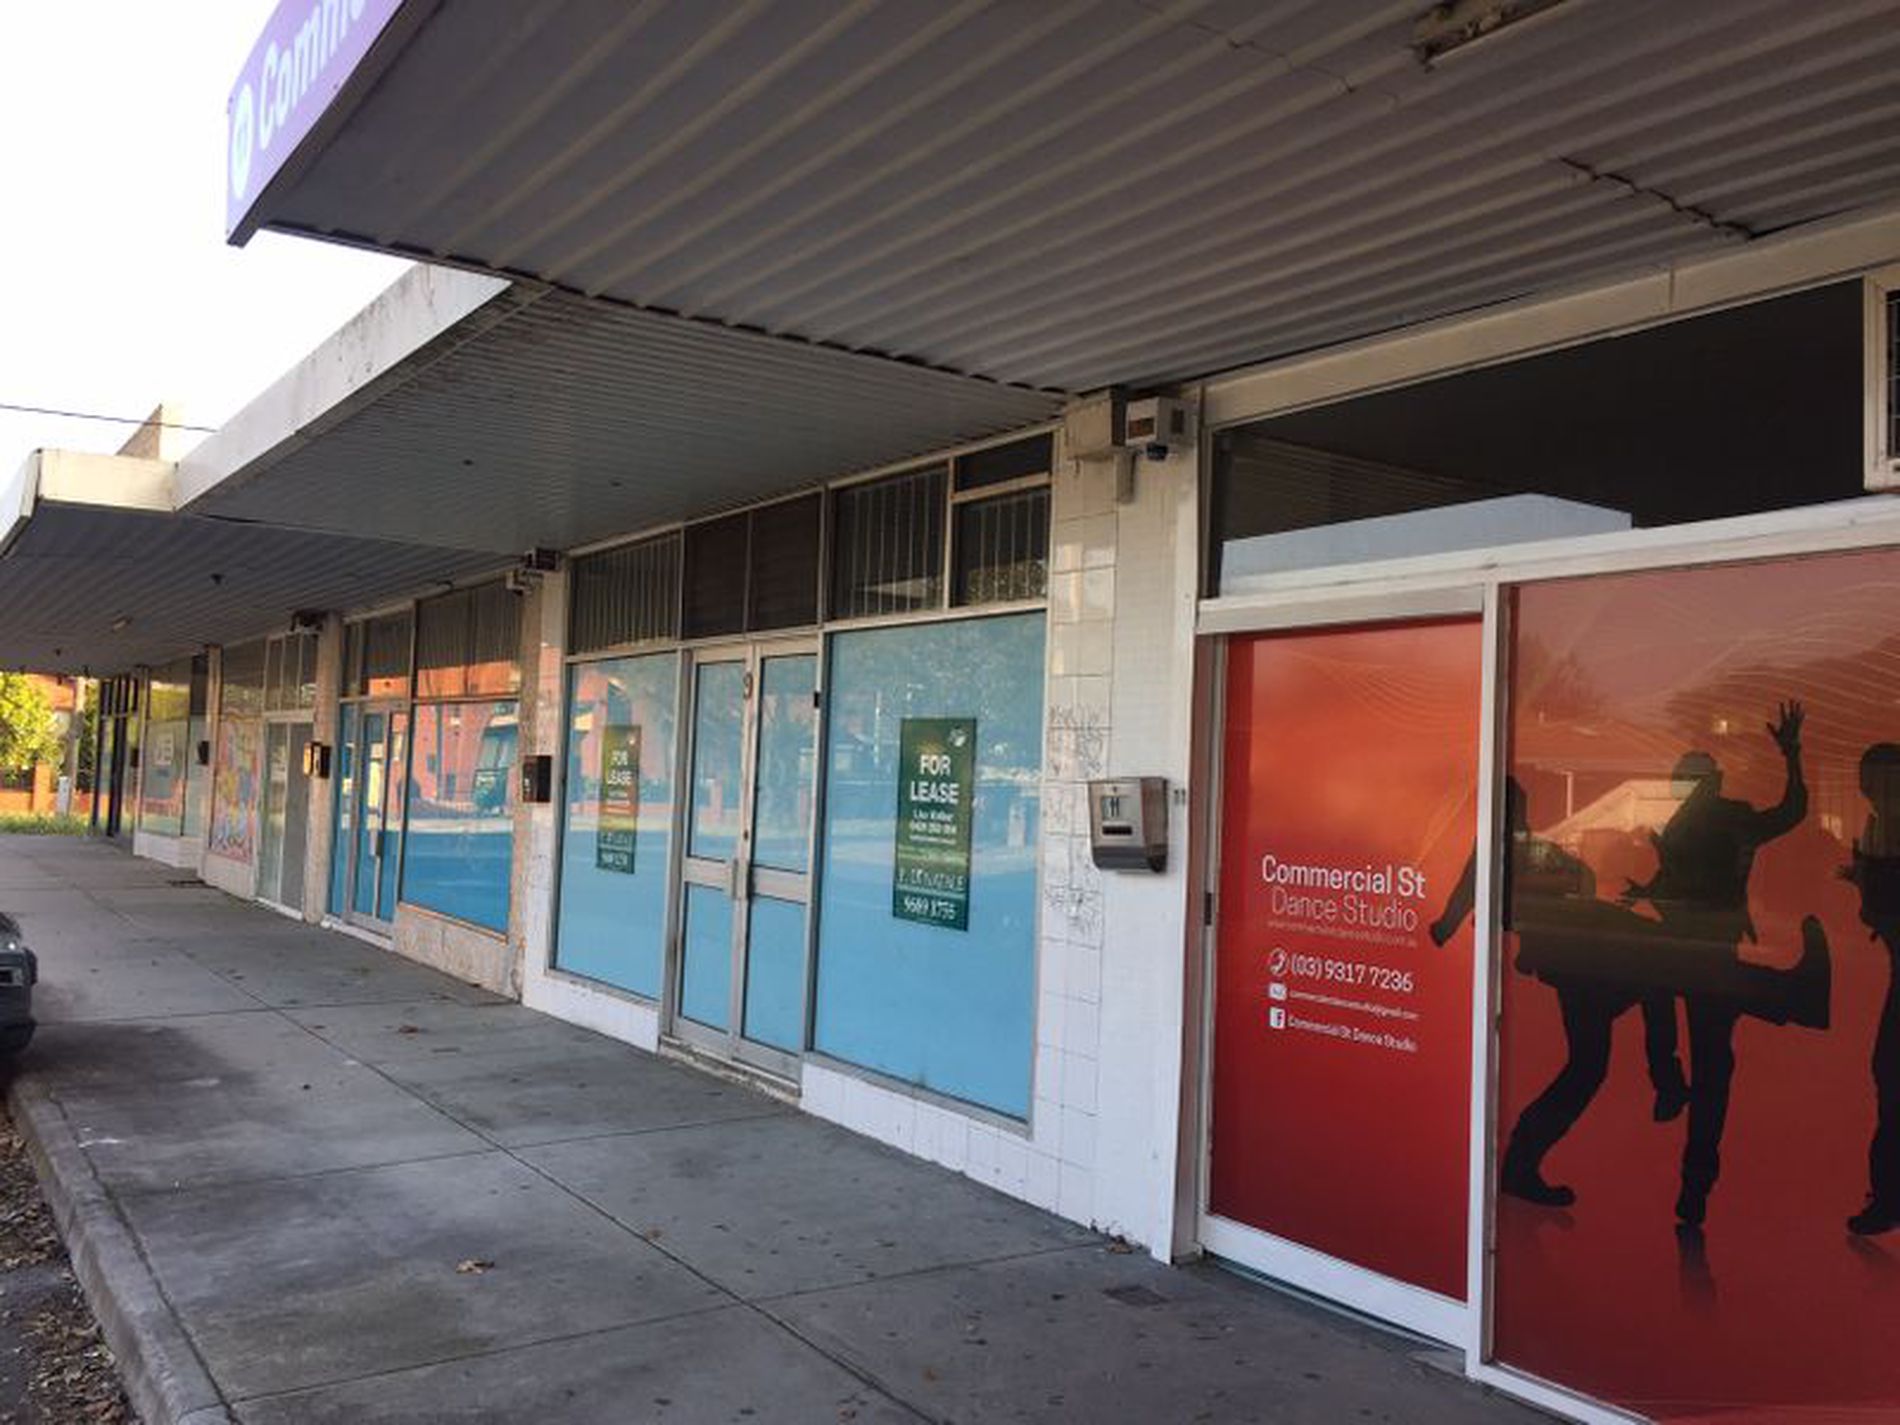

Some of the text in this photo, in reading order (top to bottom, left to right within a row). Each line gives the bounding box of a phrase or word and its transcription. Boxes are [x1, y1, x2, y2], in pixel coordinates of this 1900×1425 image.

[920, 754, 951, 776] FOR
[910, 781, 959, 805] LEASE
[1262, 855, 1426, 899] Commercial St
[1272, 885, 1418, 932] Dance Studio
[1291, 953, 1414, 993] (03) 9317 7236
